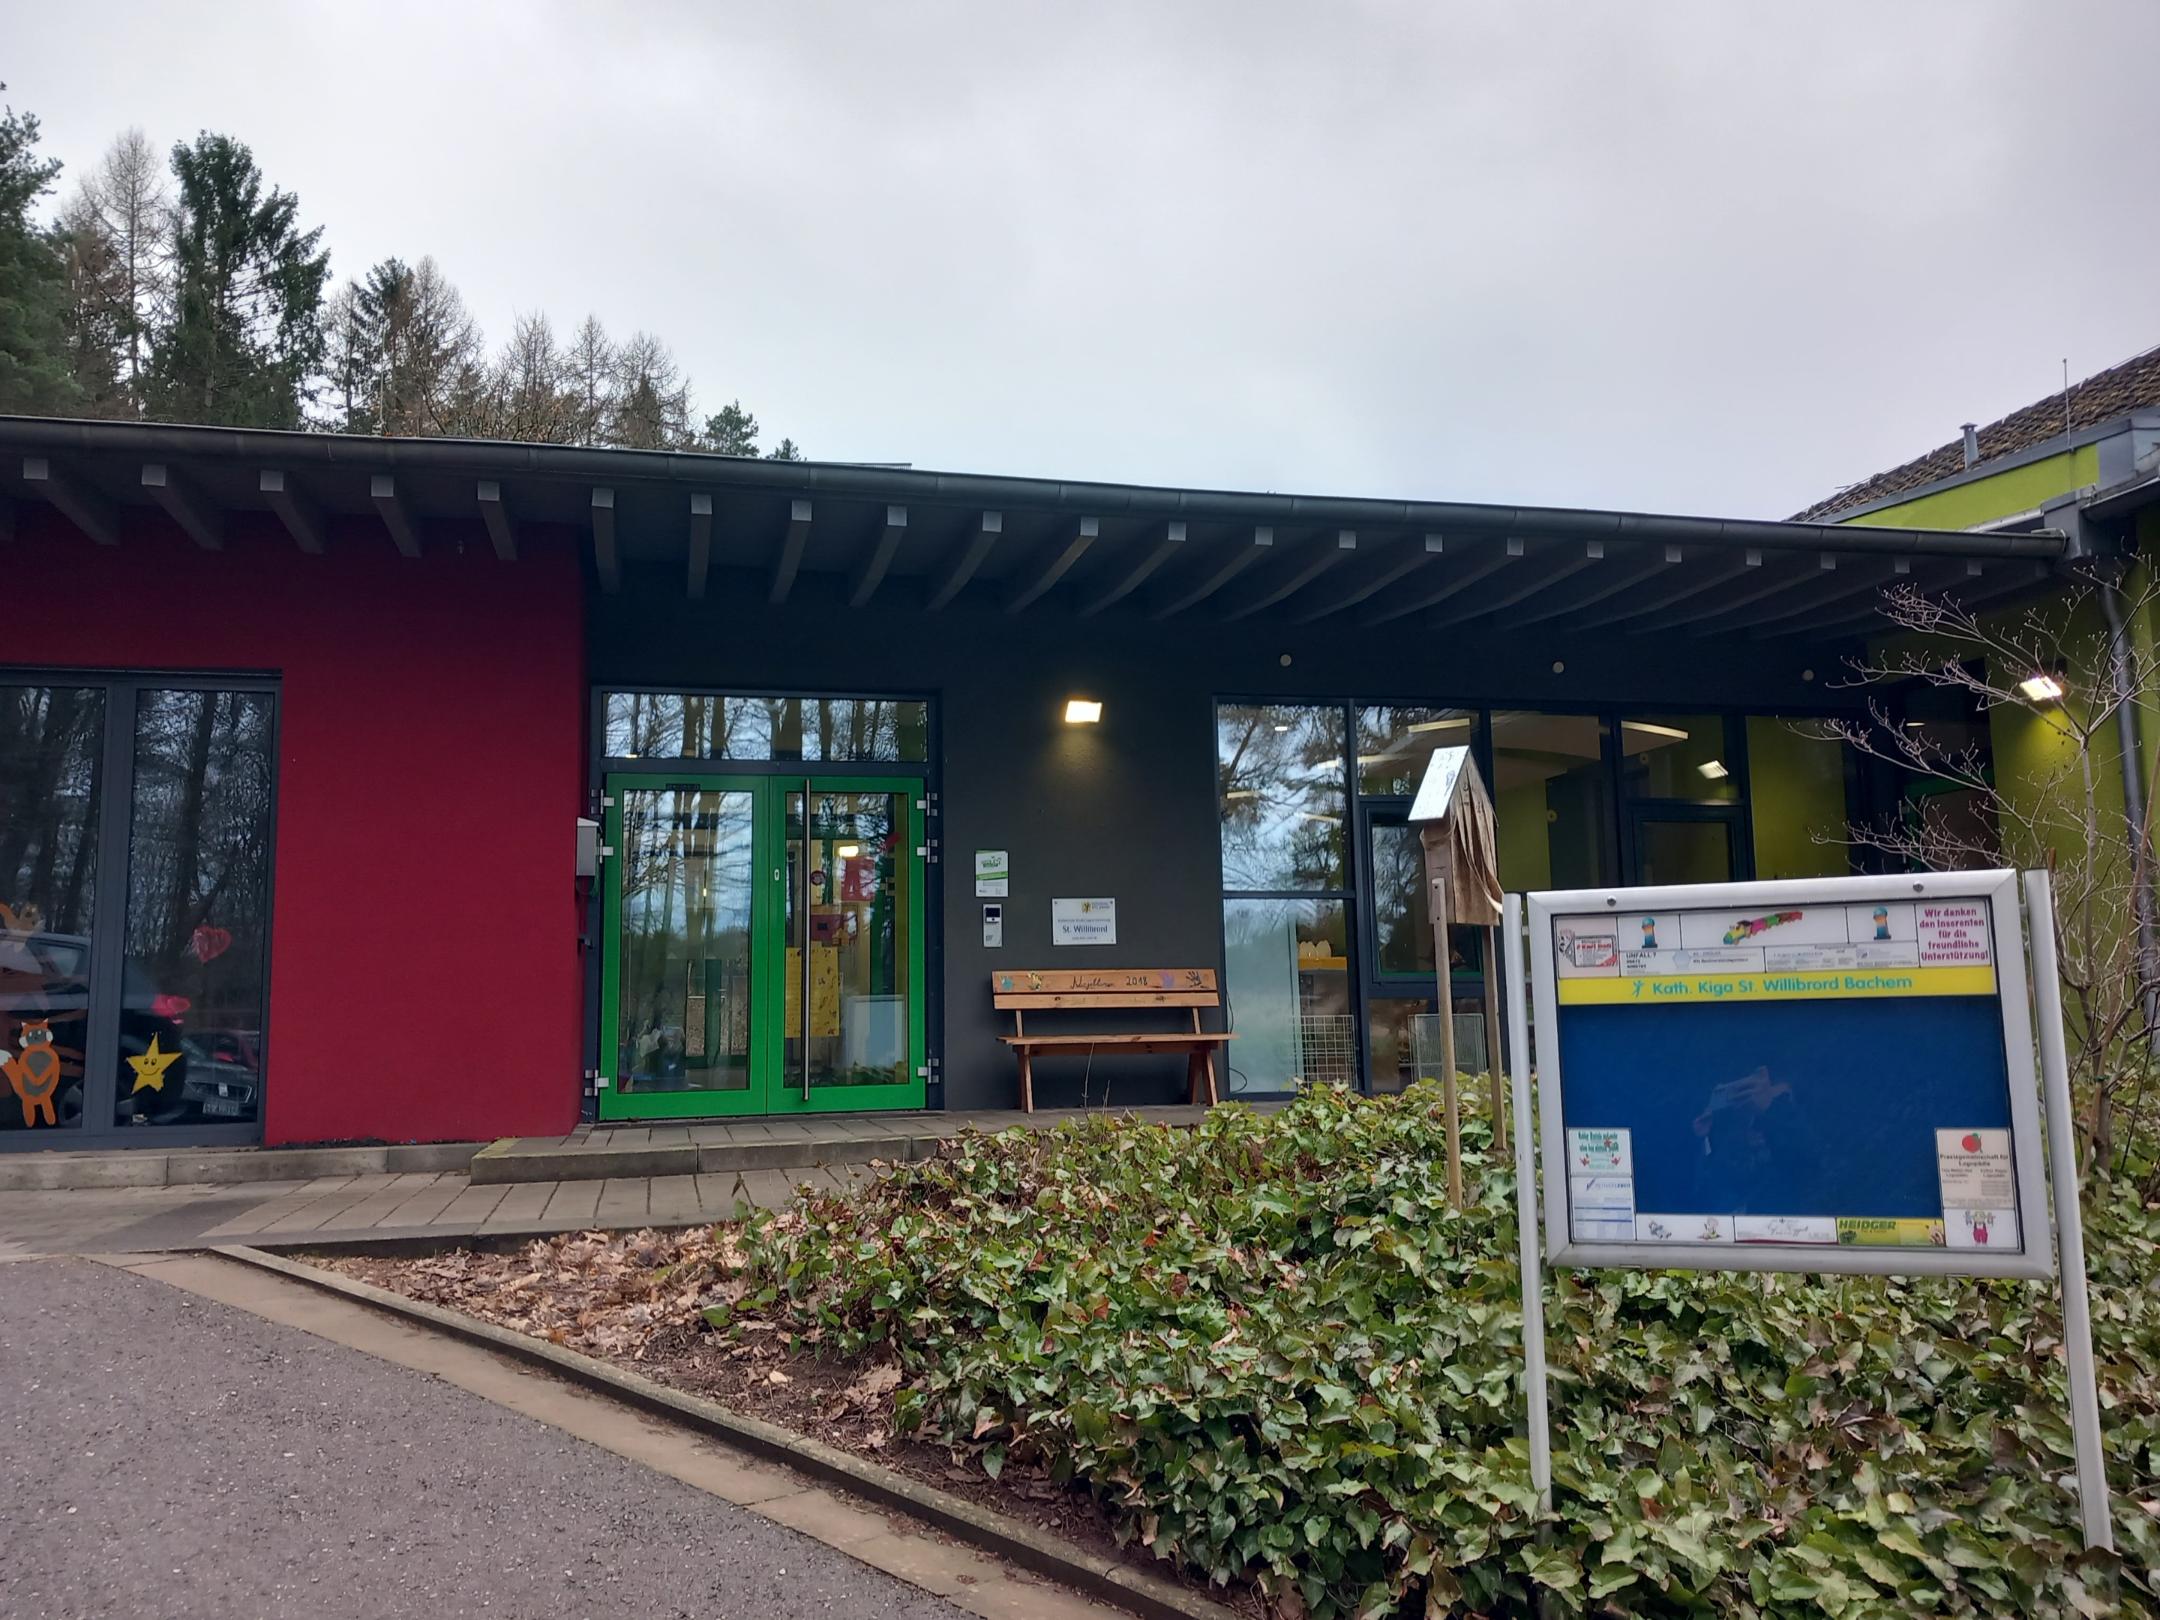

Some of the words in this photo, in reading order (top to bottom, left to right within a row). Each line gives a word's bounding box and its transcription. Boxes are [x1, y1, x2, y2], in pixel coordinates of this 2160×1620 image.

[1924, 908, 1941, 918] Wir
[1943, 907, 1977, 917] danken
[1062, 925, 1071, 933] St.
[1073, 924, 1108, 933] Willibrord
[1919, 920, 1935, 928] den
[1937, 919, 1985, 928] Inserenten
[1938, 930, 1951, 939] für
[1953, 929, 1967, 938] die
[1928, 940, 1979, 950] freundliche
[1626, 951, 1651, 959] UNFALL
[1920, 949, 1989, 960] Unterstützung!
[1126, 975, 1148, 986] 2018
[1652, 980, 1693, 995] Kath.
[1698, 980, 1733, 997] Kiga
[1738, 979, 1758, 993] St.
[1763, 976, 1839, 992] Willibrord
[1844, 974, 1913, 990] Bachem
[1838, 1219, 1897, 1230] HEIDGER
